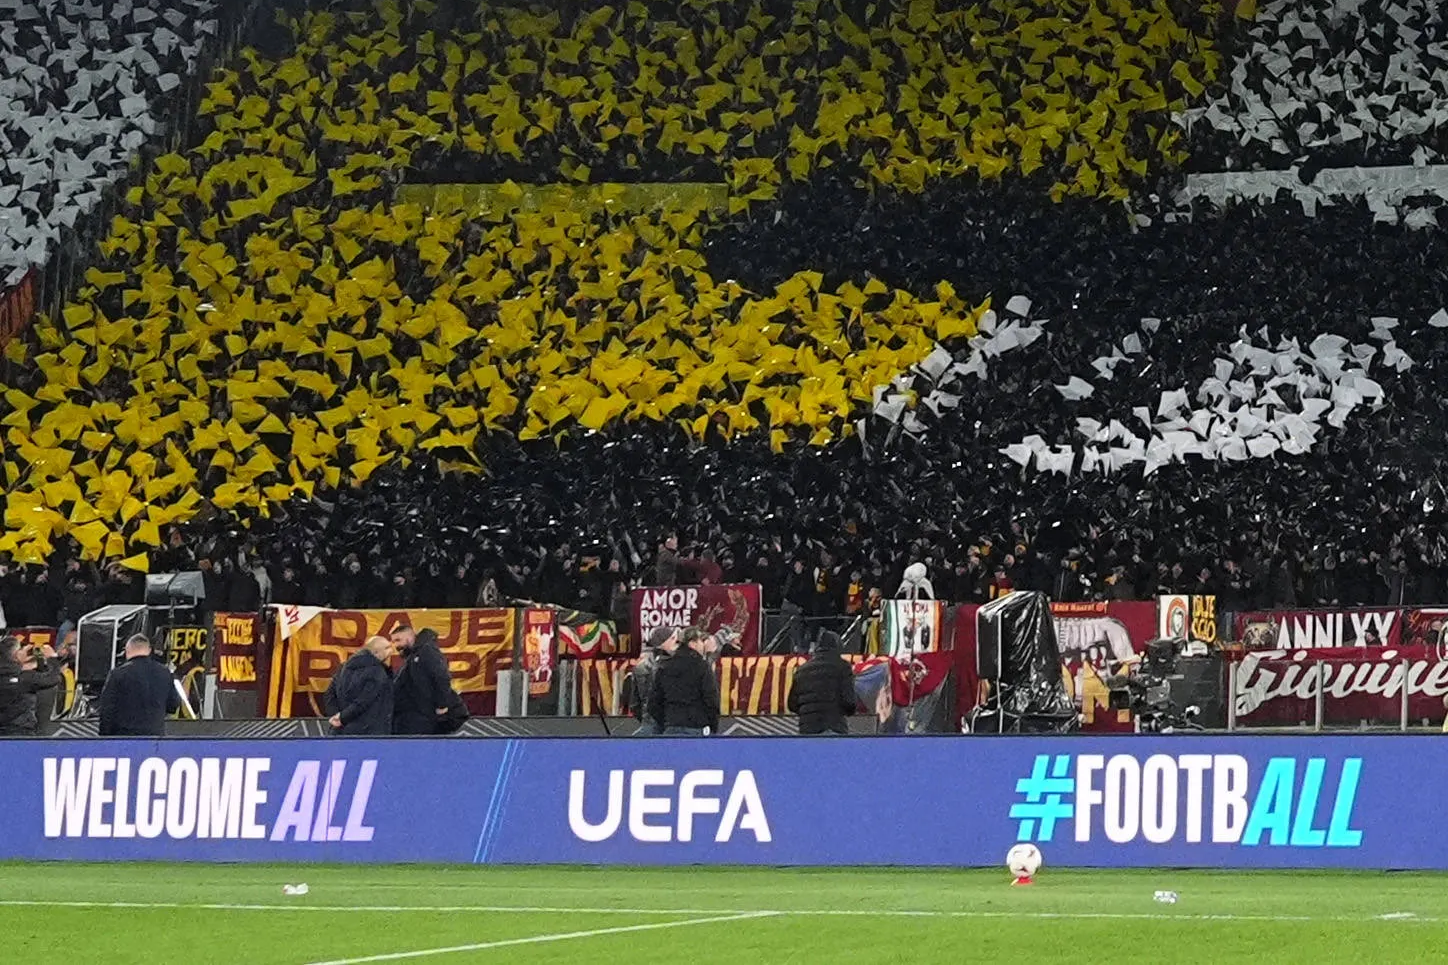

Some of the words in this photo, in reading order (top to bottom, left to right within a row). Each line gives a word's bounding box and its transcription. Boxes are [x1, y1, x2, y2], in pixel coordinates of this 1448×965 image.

[640, 588, 698, 610] AMOR
[640, 609, 692, 628] ROMAE
[1276, 613, 1343, 648] ANNI
[43, 756, 271, 840] WELCOME
[270, 759, 378, 842] ALL
[568, 769, 772, 842] UEFA
[1009, 754, 1364, 847] #FOOTBALL
